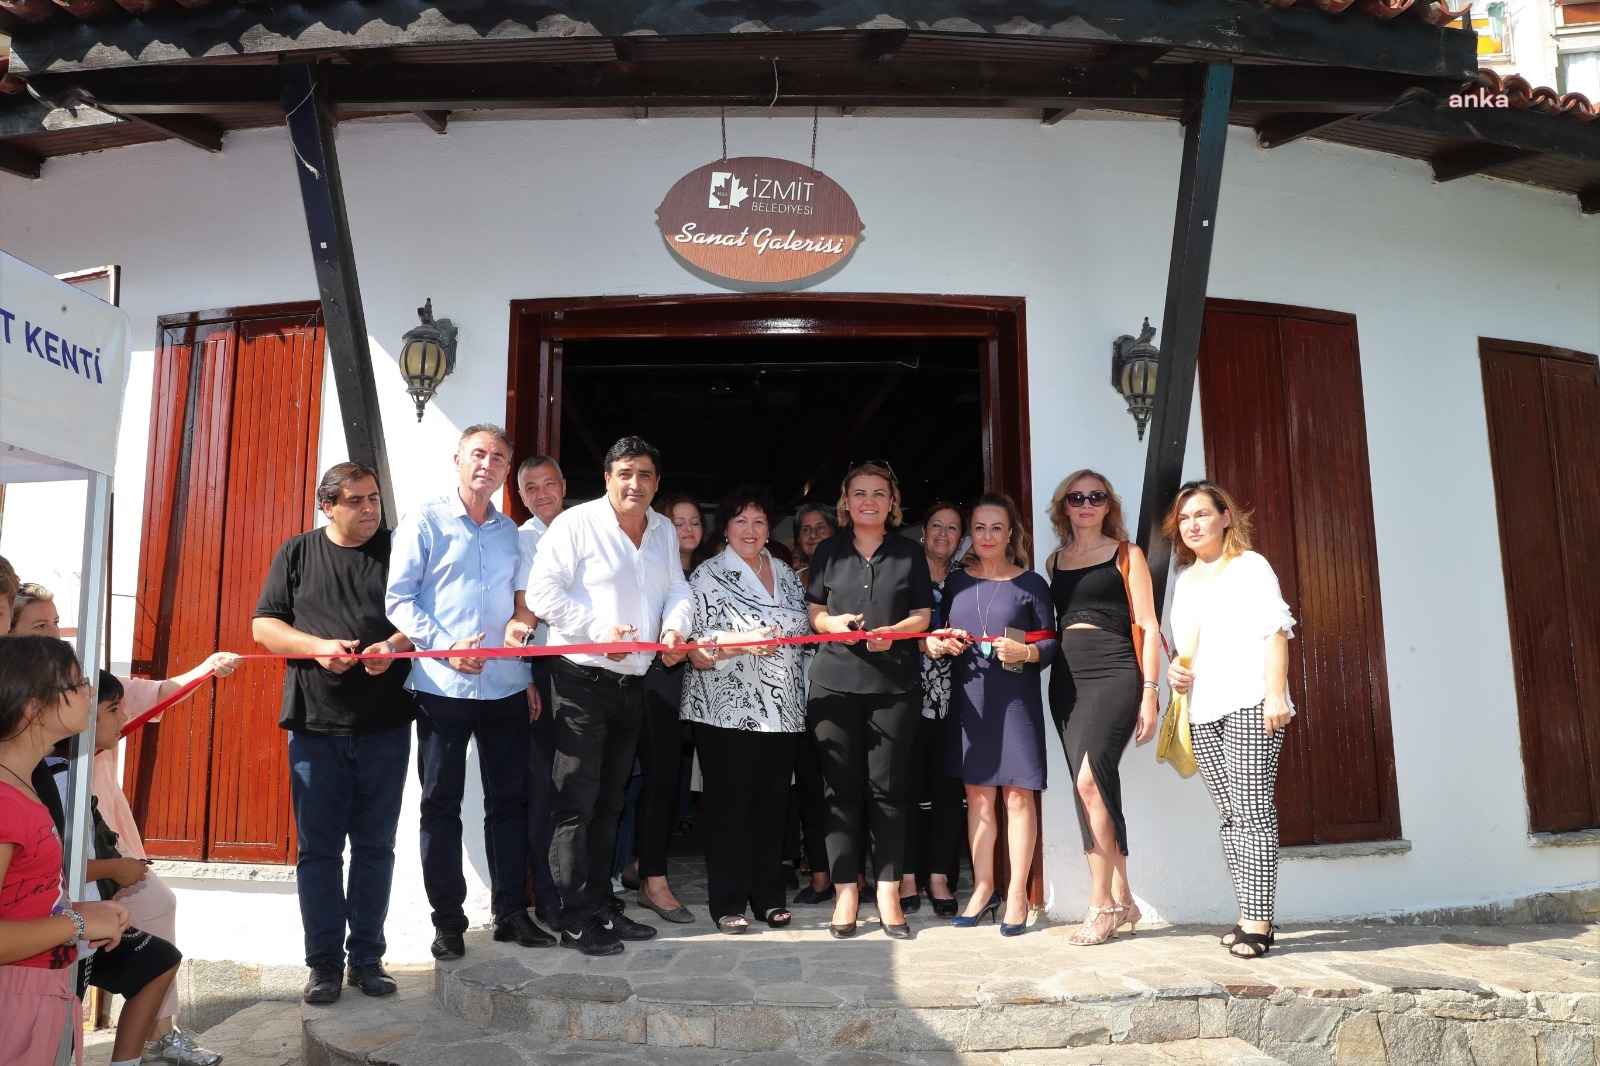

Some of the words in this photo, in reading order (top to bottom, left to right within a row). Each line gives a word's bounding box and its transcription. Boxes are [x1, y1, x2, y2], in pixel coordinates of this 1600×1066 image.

[752, 173, 815, 202] İZMİT
[751, 201, 814, 216] BELEDİYESİ
[674, 222, 749, 246] Sanat
[753, 227, 844, 255] Galerisi
[0, 308, 16, 344] T
[24, 320, 103, 385] KENTİ
